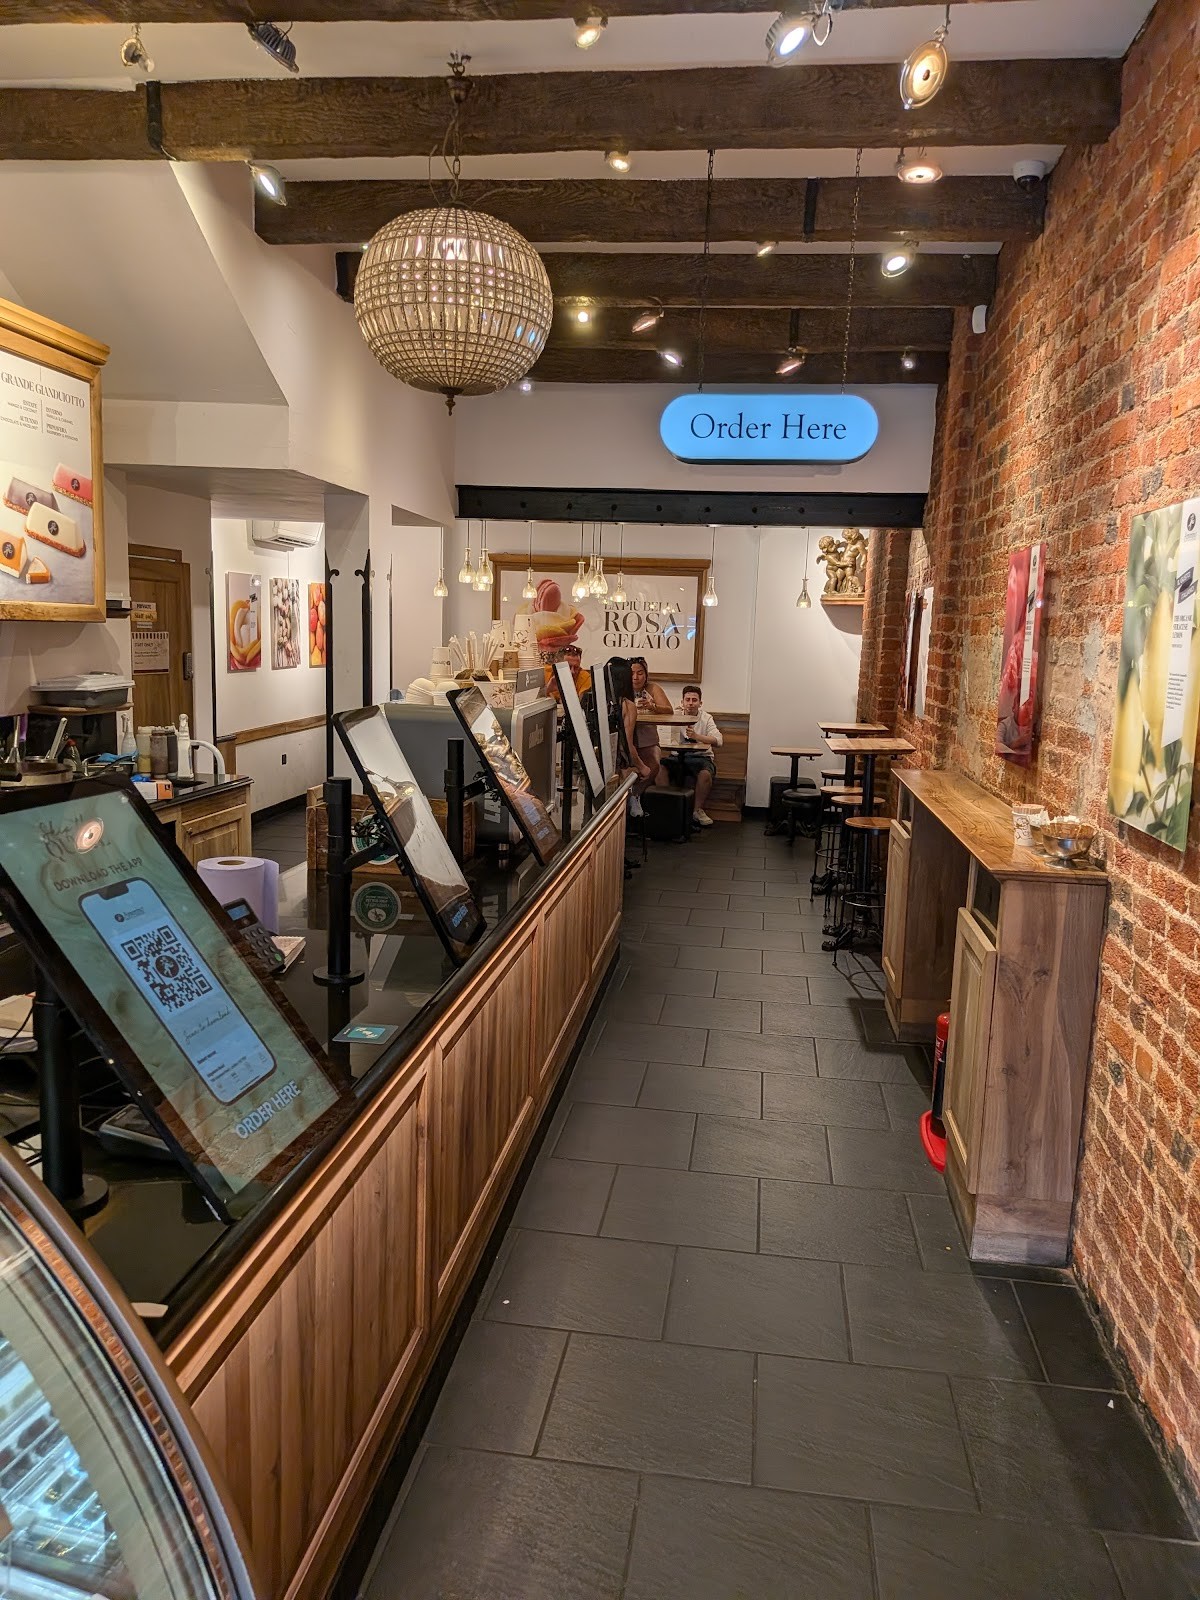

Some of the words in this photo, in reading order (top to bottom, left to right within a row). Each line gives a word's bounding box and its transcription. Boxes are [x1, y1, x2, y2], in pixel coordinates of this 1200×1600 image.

[1, 372, 34, 392] GRANDE
[35, 384, 85, 408] GIANDUIOTTO
[690, 412, 771, 439] Order
[781, 413, 847, 440] Here
[604, 611, 680, 634] ROSA
[603, 632, 680, 650] GELATO
[54, 868, 109, 892] DOWNLOAD
[108, 863, 128, 874] THE
[128, 857, 143, 869] APP
[235, 1102, 276, 1139] ORDER
[271, 1080, 301, 1109] HERE
